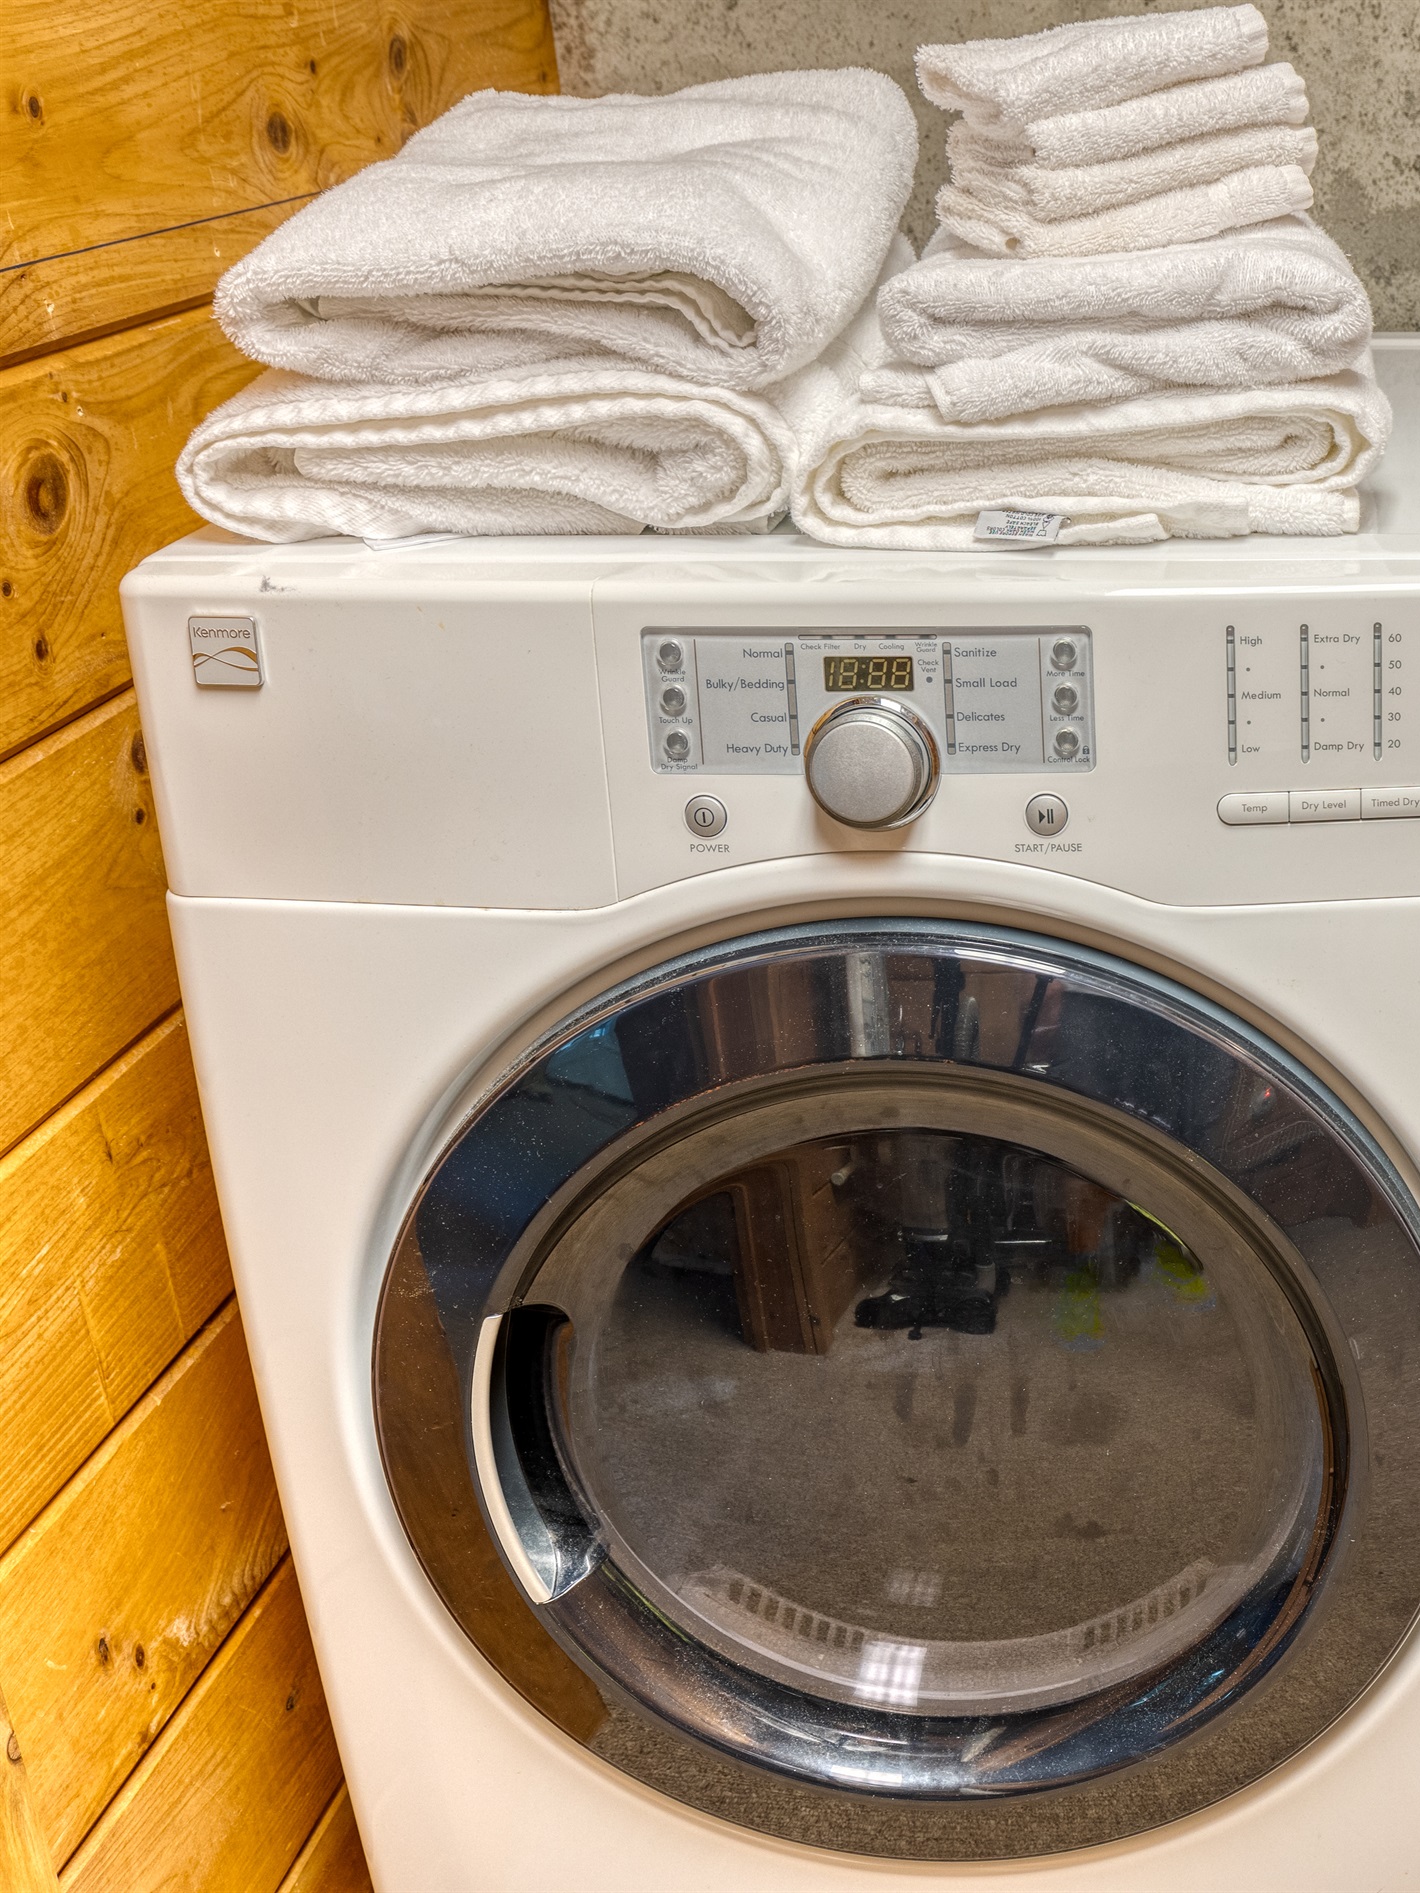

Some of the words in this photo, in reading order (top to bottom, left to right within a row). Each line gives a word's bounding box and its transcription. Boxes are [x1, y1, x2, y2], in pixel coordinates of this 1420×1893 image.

[192, 626, 251, 639] Kenmore
[1388, 633, 1402, 643] 60
[1239, 636, 1263, 647] High
[1313, 634, 1340, 644] Extra
[1343, 634, 1361, 647] Dry
[854, 643, 867, 652] Dry
[878, 643, 905, 651] Cooling
[954, 647, 997, 658] Sanitize
[742, 648, 783, 659] Normal
[1388, 660, 1402, 670] 50
[658, 668, 686, 676] Wrinkle
[706, 677, 785, 692] Bulky/Bedding
[955, 677, 986, 688] Small
[990, 677, 1018, 688] Load
[1241, 690, 1282, 700] Medium
[1313, 687, 1350, 697] Normal
[1388, 686, 1402, 696] 40
[682, 717, 693, 725] Up
[750, 712, 787, 723] Casual
[956, 711, 1006, 722] Delicates
[1387, 711, 1402, 722] 30
[958, 743, 998, 754] Express
[1001, 742, 1021, 754] Dry
[1241, 744, 1261, 754] Low
[1314, 741, 1344, 753] Damp
[1346, 740, 1365, 753] Dry
[1387, 739, 1402, 749] 20
[726, 743, 761, 756] Heavy
[764, 743, 789, 757] Duty
[667, 757, 688, 765] Damp
[1047, 756, 1073, 764] Control
[1074, 756, 1090, 764] Lock
[1301, 801, 1320, 813] Dry
[1322, 800, 1347, 810] Level
[1371, 797, 1400, 808] Timed
[1402, 796, 1420, 809] Dry
[1242, 804, 1268, 814] Temp
[689, 843, 731, 854] POWER
[1014, 842, 1083, 856] START/PAUSE
